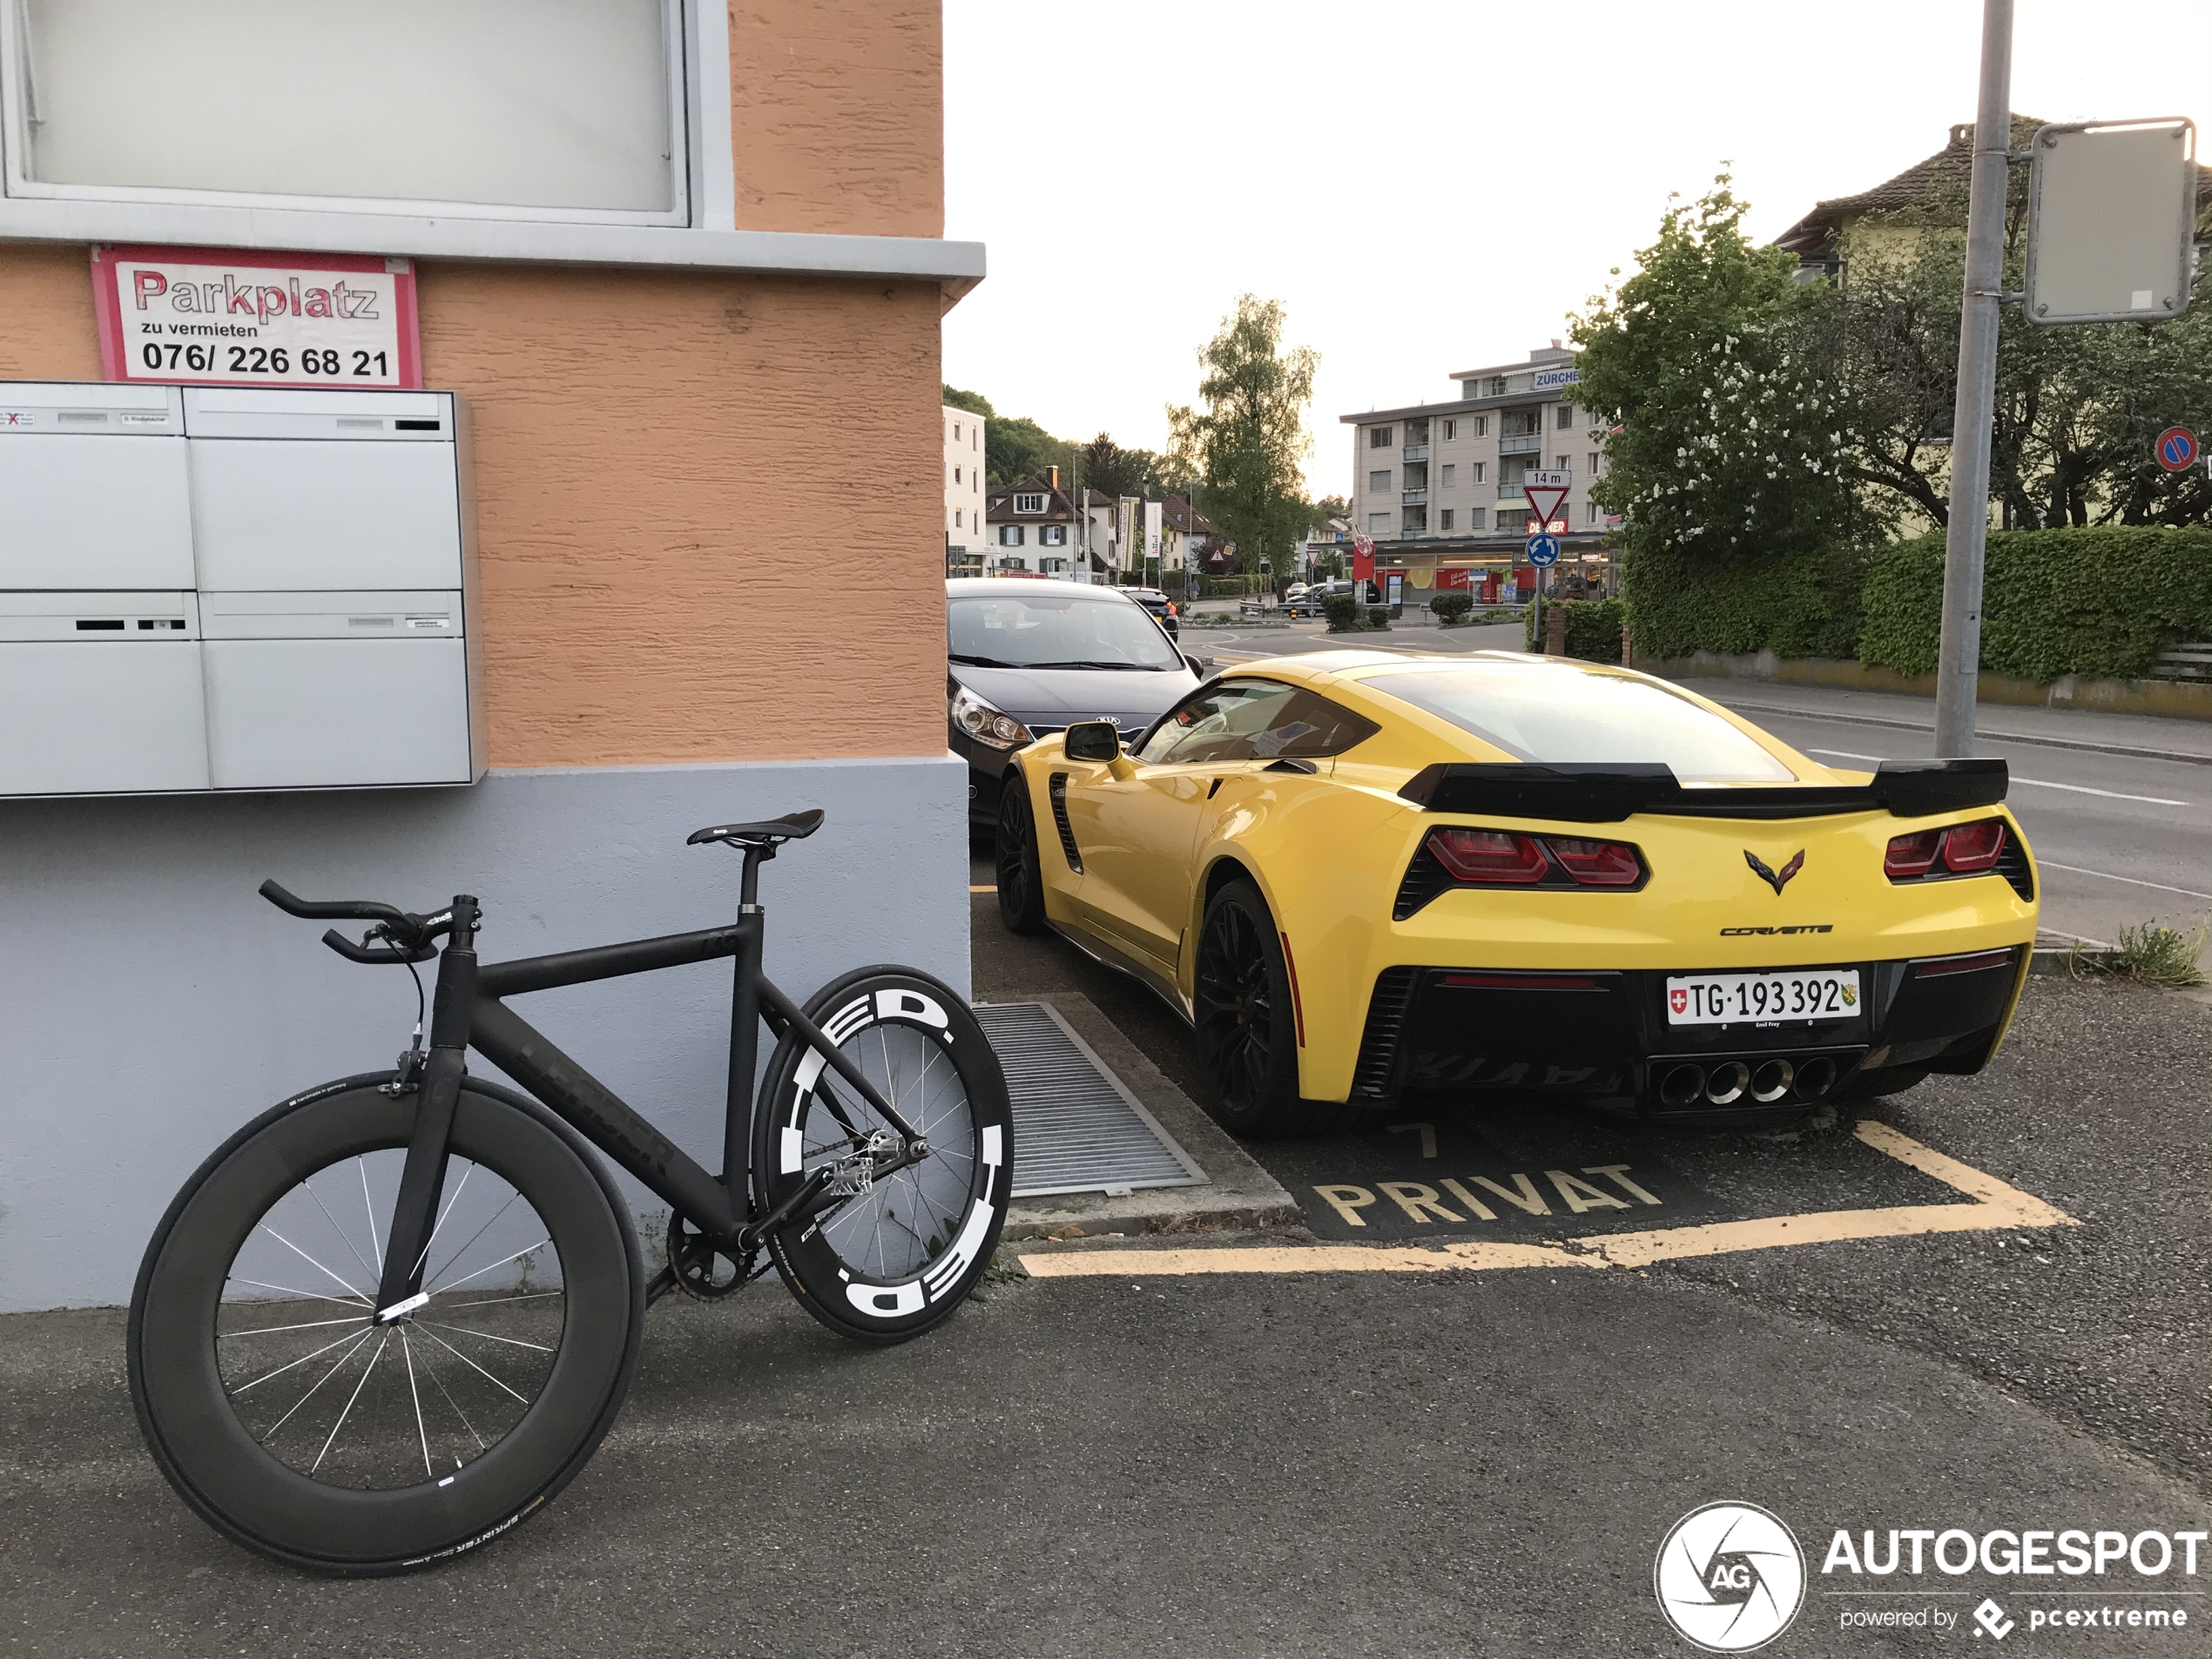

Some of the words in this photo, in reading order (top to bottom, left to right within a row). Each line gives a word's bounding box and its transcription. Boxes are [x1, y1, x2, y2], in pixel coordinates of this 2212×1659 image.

[133, 270, 380, 325] Parkplatz
[141, 322, 163, 334] zu
[168, 323, 259, 337] vermieten
[143, 343, 216, 372] 076/
[229, 347, 290, 374] 226
[301, 349, 341, 375] 68
[352, 350, 388, 377] 21
[1536, 370, 1579, 385] ZÜRCHE
[1534, 473, 1548, 483] 14
[1550, 474, 1561, 483] m
[1528, 521, 1565, 534] DENER
[1720, 925, 1834, 936] CORVETTE
[1312, 1164, 1663, 1226] PRIVAT
[455, 1514, 519, 1553] SPRINTER
